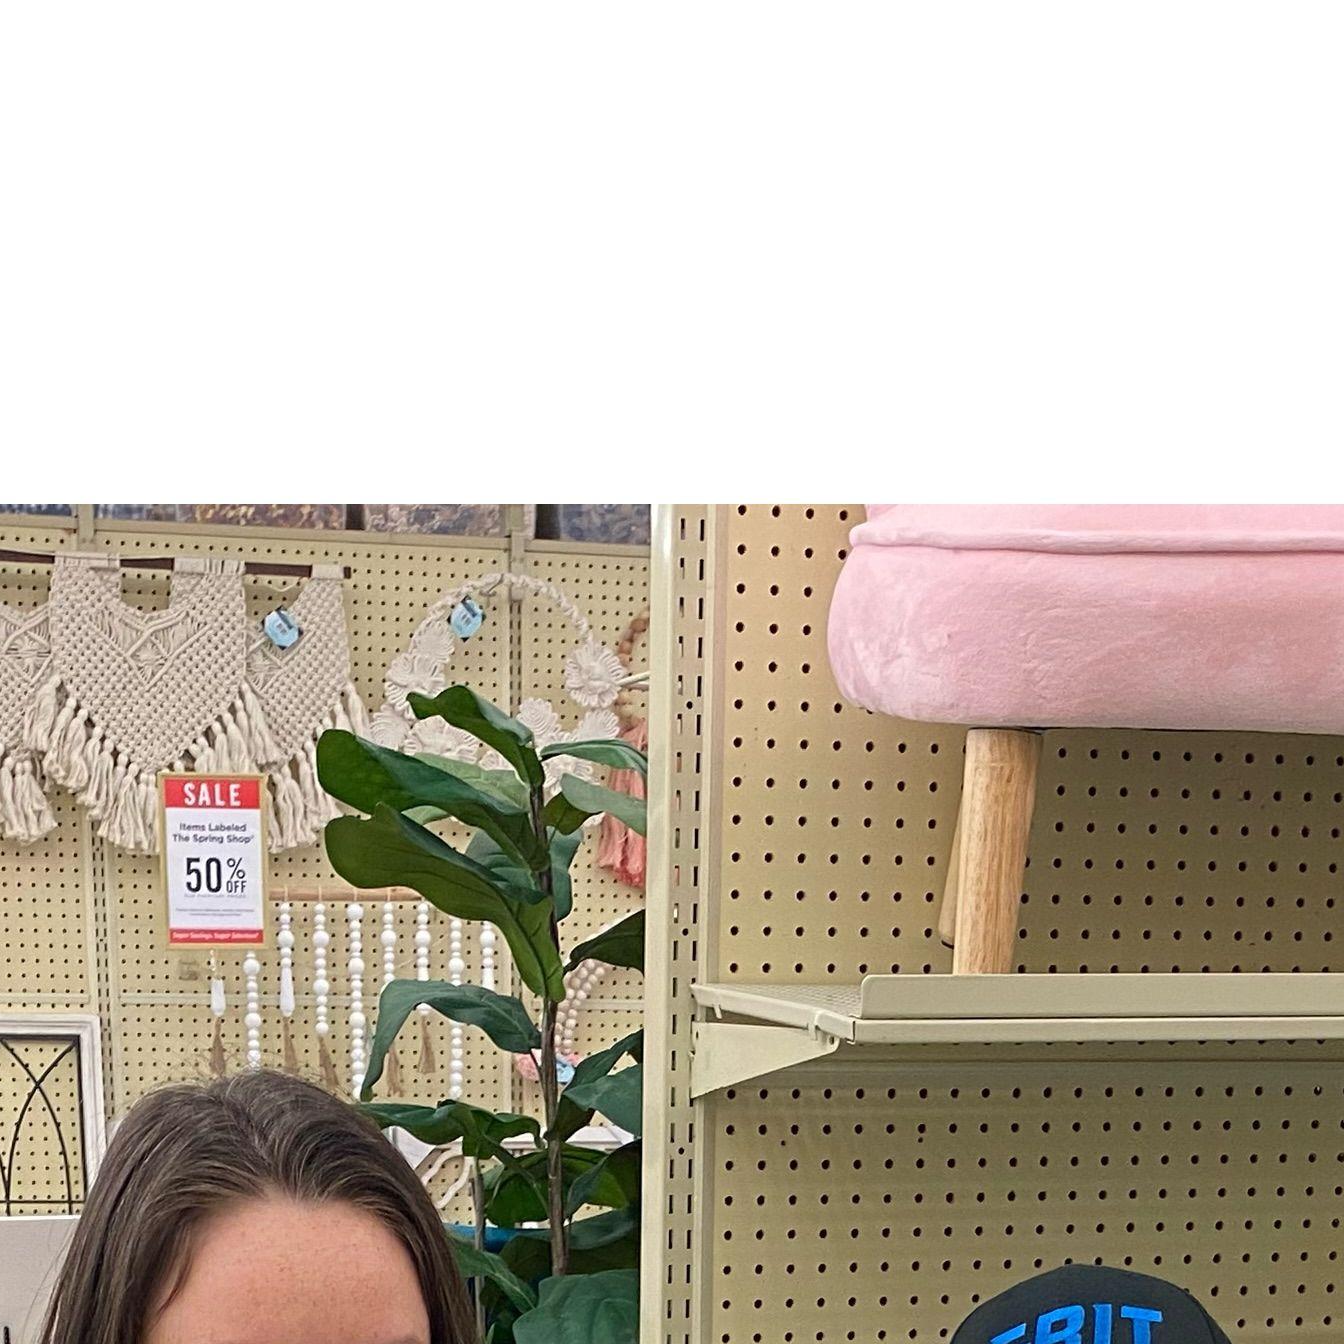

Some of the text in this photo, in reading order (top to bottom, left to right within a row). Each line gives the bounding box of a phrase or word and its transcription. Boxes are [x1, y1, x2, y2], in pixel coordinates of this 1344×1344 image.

[183, 782, 241, 807] SALE
[179, 823, 247, 832] Items Labeled
[173, 834, 191, 843] The
[193, 834, 224, 844] Spring
[226, 880, 247, 894] OFF
